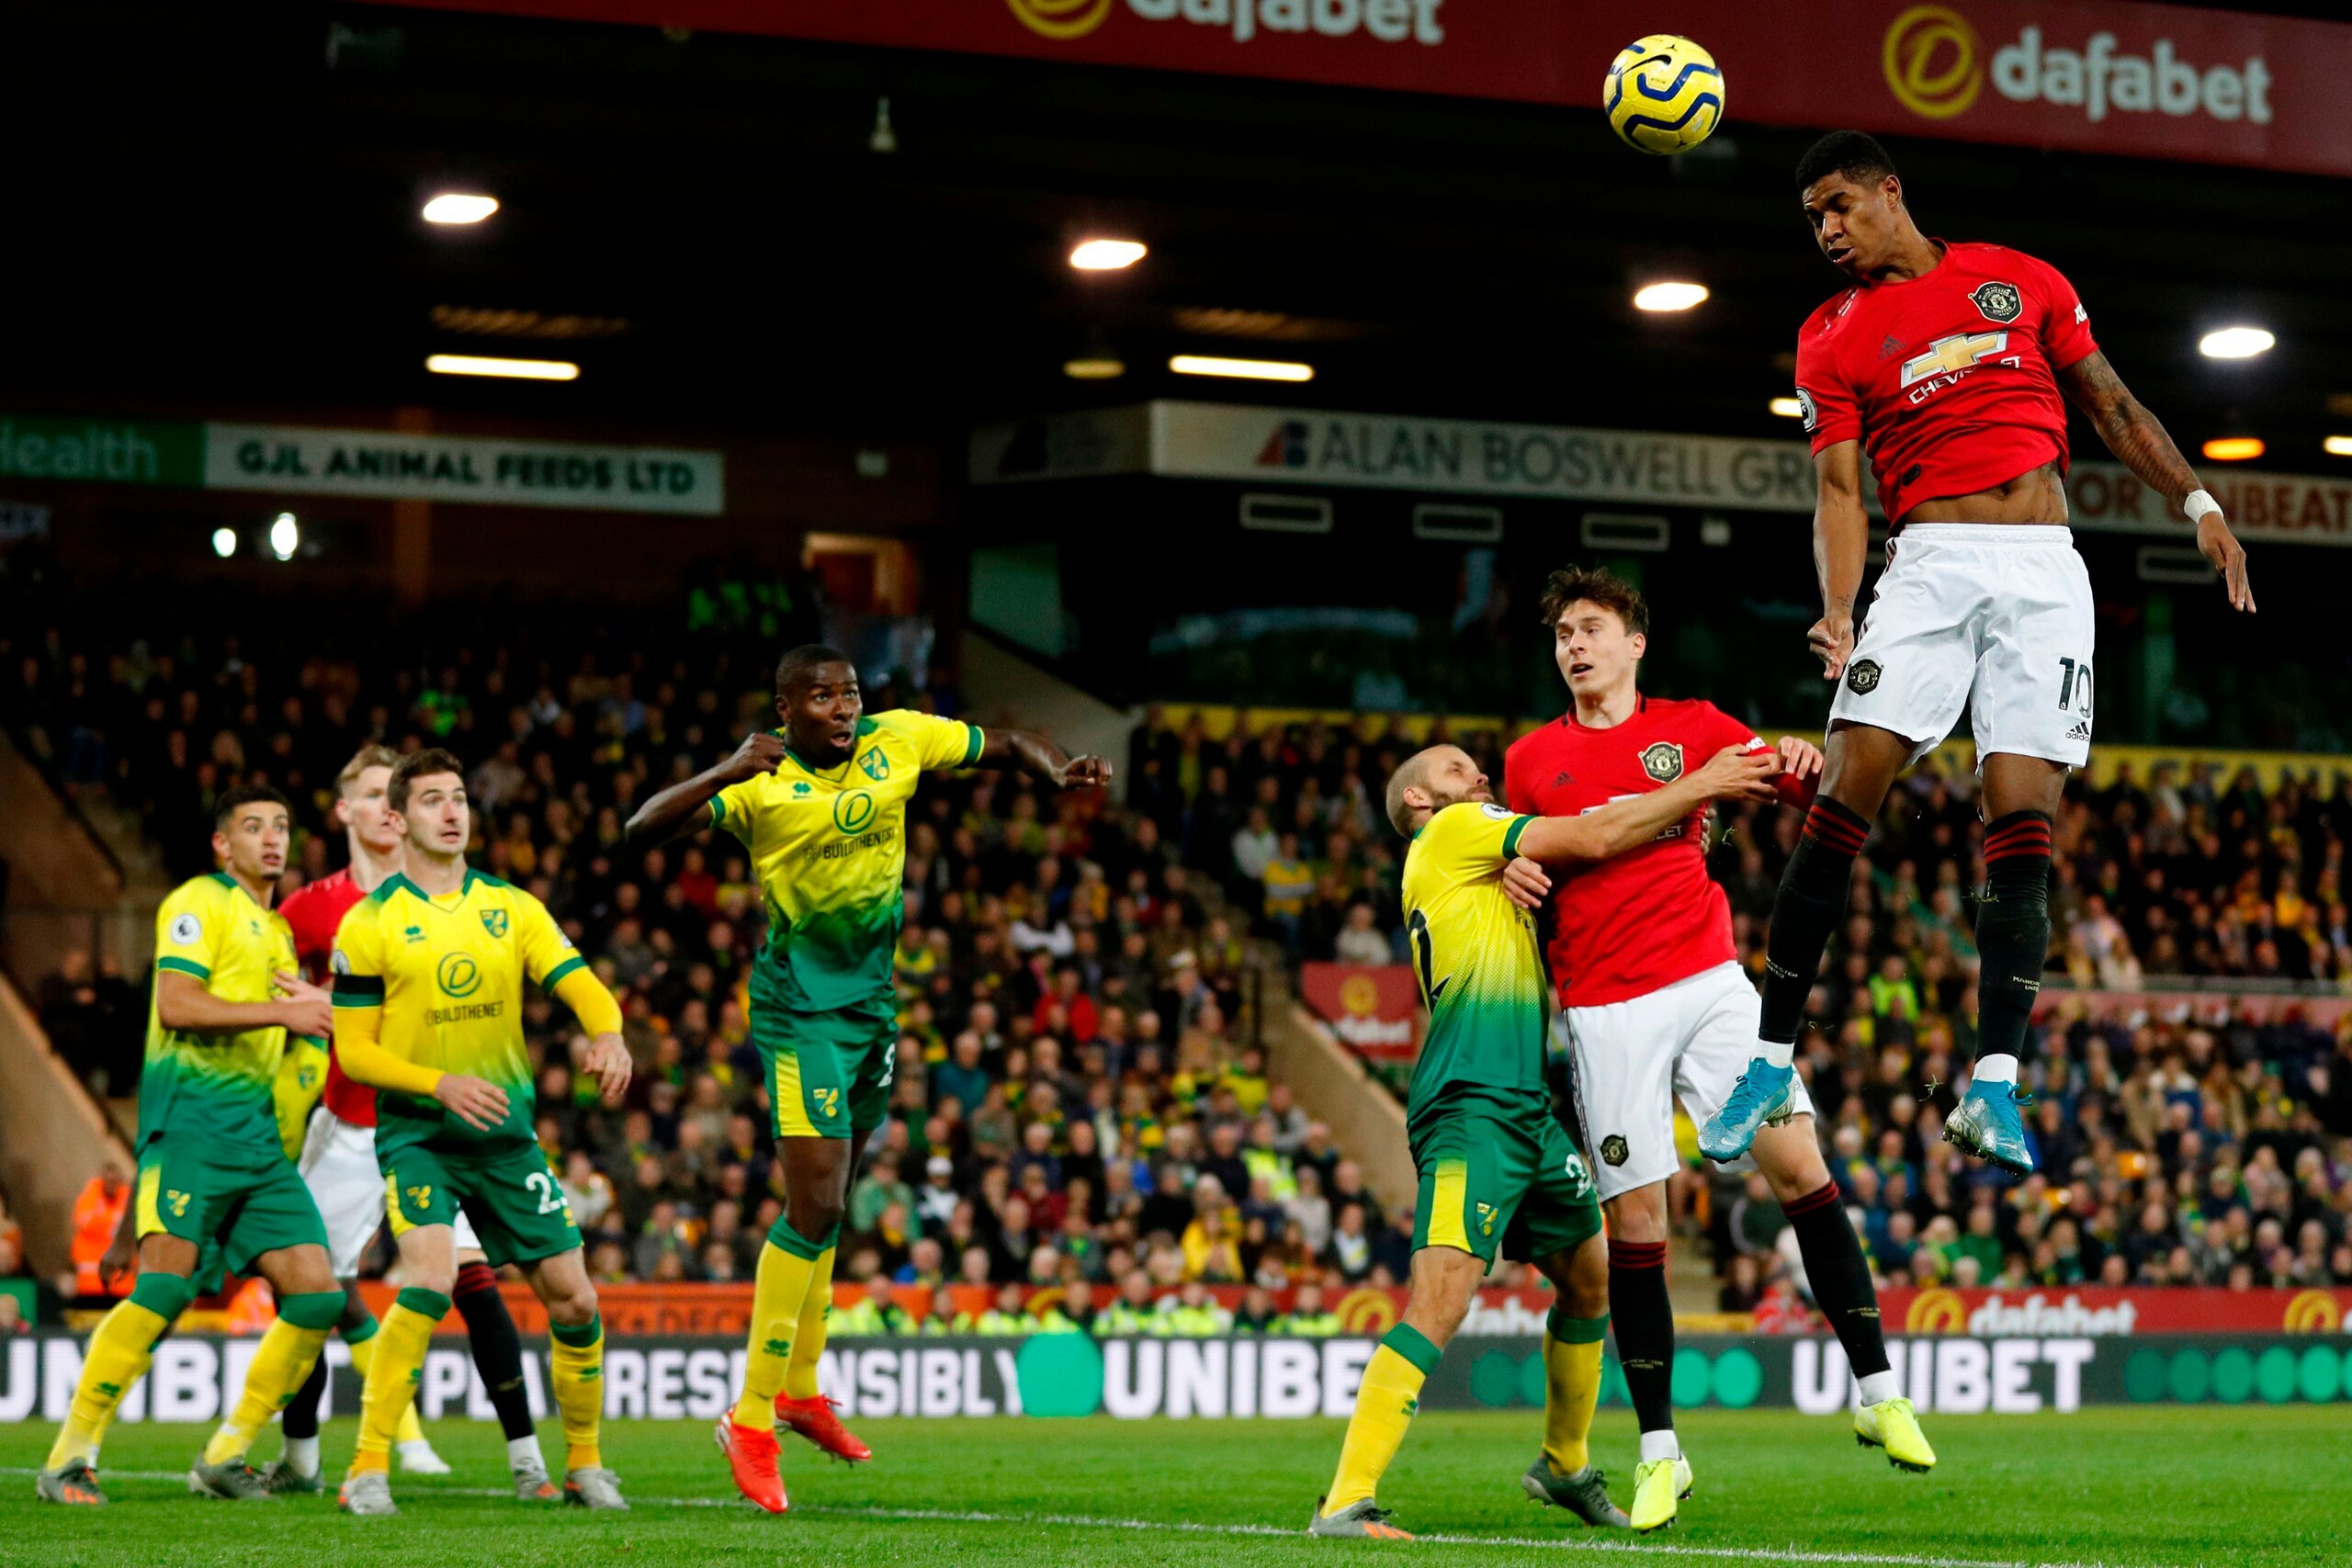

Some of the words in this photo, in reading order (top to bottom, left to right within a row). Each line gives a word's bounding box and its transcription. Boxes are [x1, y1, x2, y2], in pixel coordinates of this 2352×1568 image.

[1990, 24, 2273, 125] dafabet
[237, 440, 309, 477] GJL
[326, 448, 480, 487] ANIMAL
[495, 456, 613, 491] FEEDS
[628, 462, 696, 496] LTD
[1317, 419, 1464, 478] ALAN
[1480, 428, 1724, 498] BOSWELL
[2058, 656, 2093, 719] 10
[2064, 732, 2091, 742] adida
[604, 1348, 1023, 1419] RESNSIBLY
[1103, 1338, 1376, 1419] UNIBE
[1792, 1338, 2097, 1416] UNIBET
